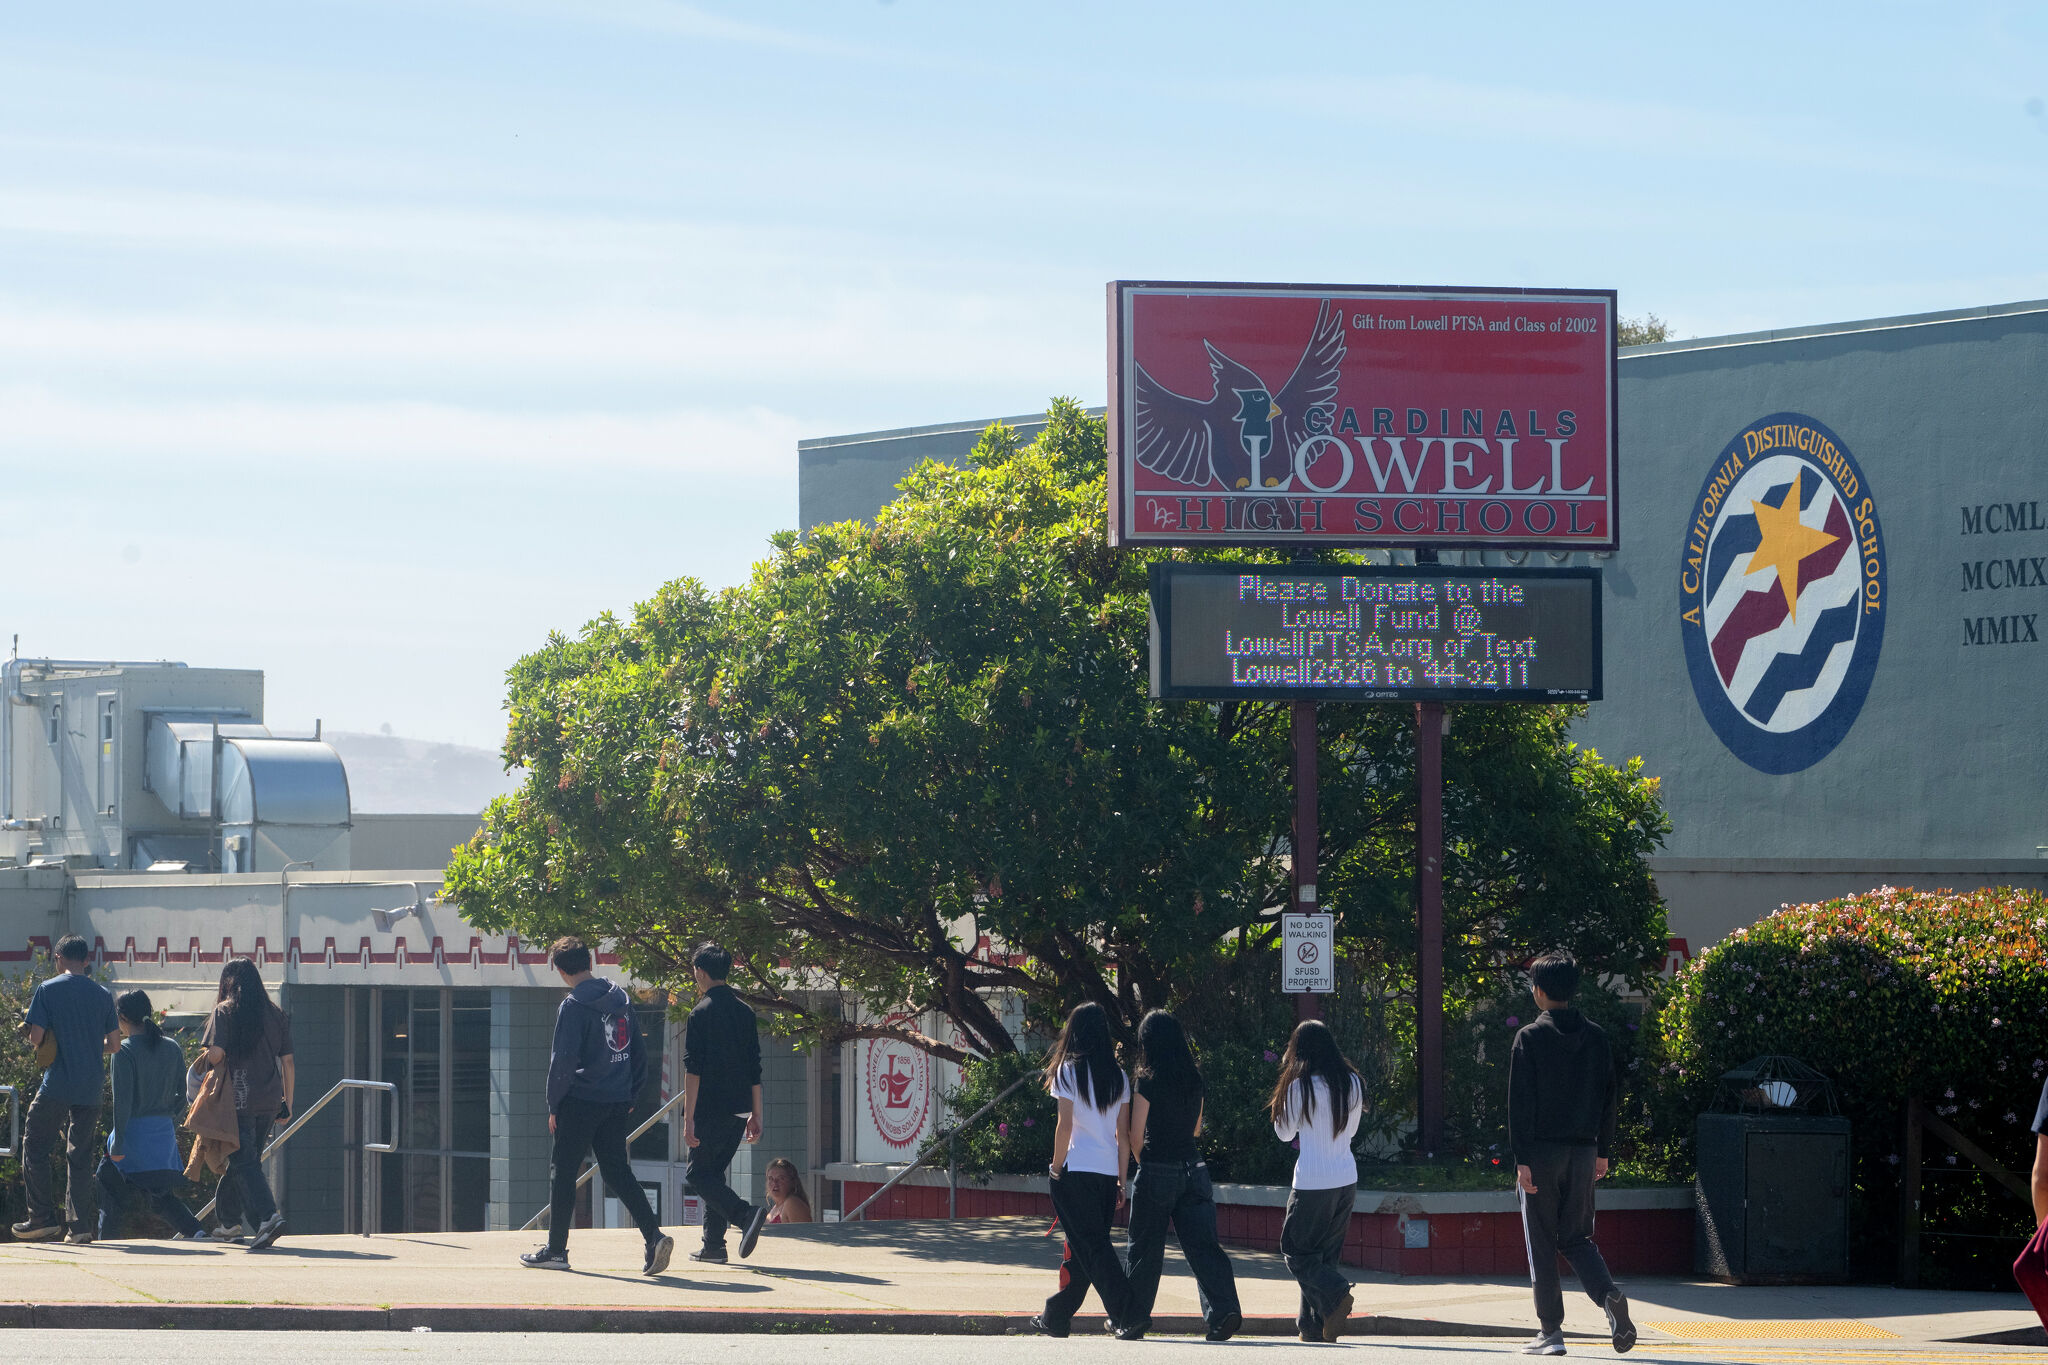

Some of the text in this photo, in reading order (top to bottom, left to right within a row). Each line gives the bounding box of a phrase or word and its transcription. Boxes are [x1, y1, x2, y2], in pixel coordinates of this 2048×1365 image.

[1352, 314, 1597, 333] Gift from Lowell PTSA and Class of 2002
[1304, 407, 1578, 436] CARDINALS
[1244, 435, 1595, 495] LOWELL
[1176, 498, 1327, 532] HIGH
[1354, 499, 1596, 534] SCHOOL
[1682, 424, 1880, 627] A CALIFORNIA DISTINGUISHED SCHOOL
[1960, 501, 2048, 535] MCML
[1240, 575, 1524, 603] Please Donate to the
[1282, 603, 1482, 636] Lowell Fund @
[1962, 614, 2039, 646] MMIX
[1444, 639, 1471, 657] or
[1480, 633, 1537, 658] Text
[1385, 662, 1413, 685] to
[1288, 978, 1329, 986] PROPERTY
[1295, 967, 1319, 975] SFUSD
